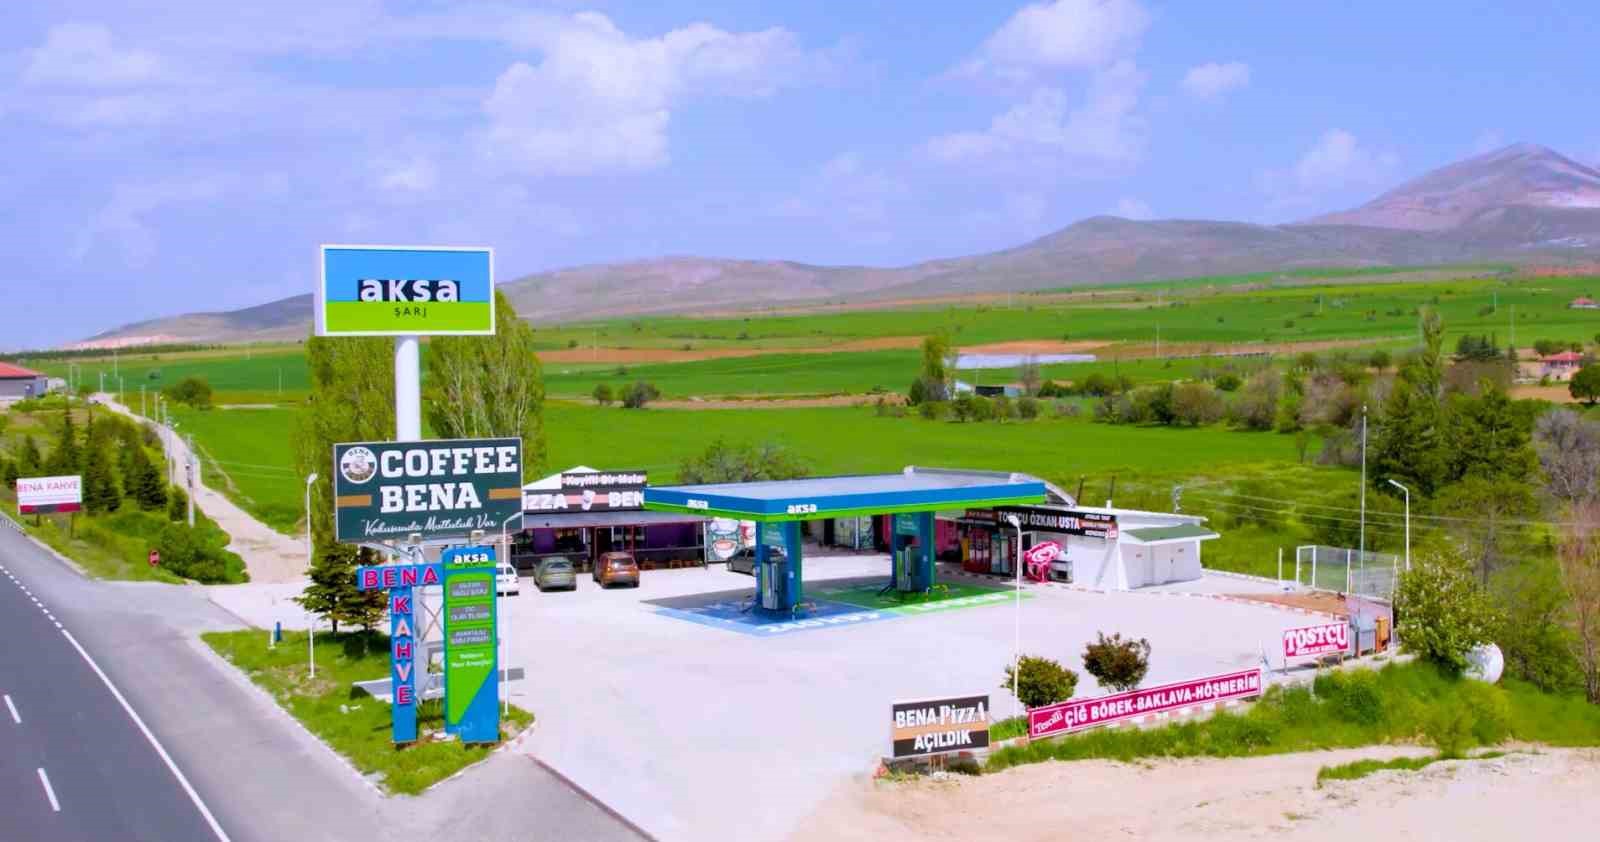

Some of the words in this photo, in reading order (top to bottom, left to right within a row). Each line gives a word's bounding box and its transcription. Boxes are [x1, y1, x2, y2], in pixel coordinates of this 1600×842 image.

[359, 278, 459, 303] aksa
[381, 445, 518, 479] COFFEE
[379, 481, 482, 514] BENA
[786, 503, 817, 514] aksa
[1029, 510, 1058, 529] ÖZKAN
[1058, 516, 1080, 530] USTA
[453, 553, 489, 564] aksa
[364, 567, 439, 588] BENA
[393, 596, 413, 705] KAHVE
[1285, 624, 1348, 654] TOSTCU
[895, 707, 937, 729] BENA
[1065, 706, 1088, 730] ÇİĞ
[914, 729, 972, 753] AÇILDIK
